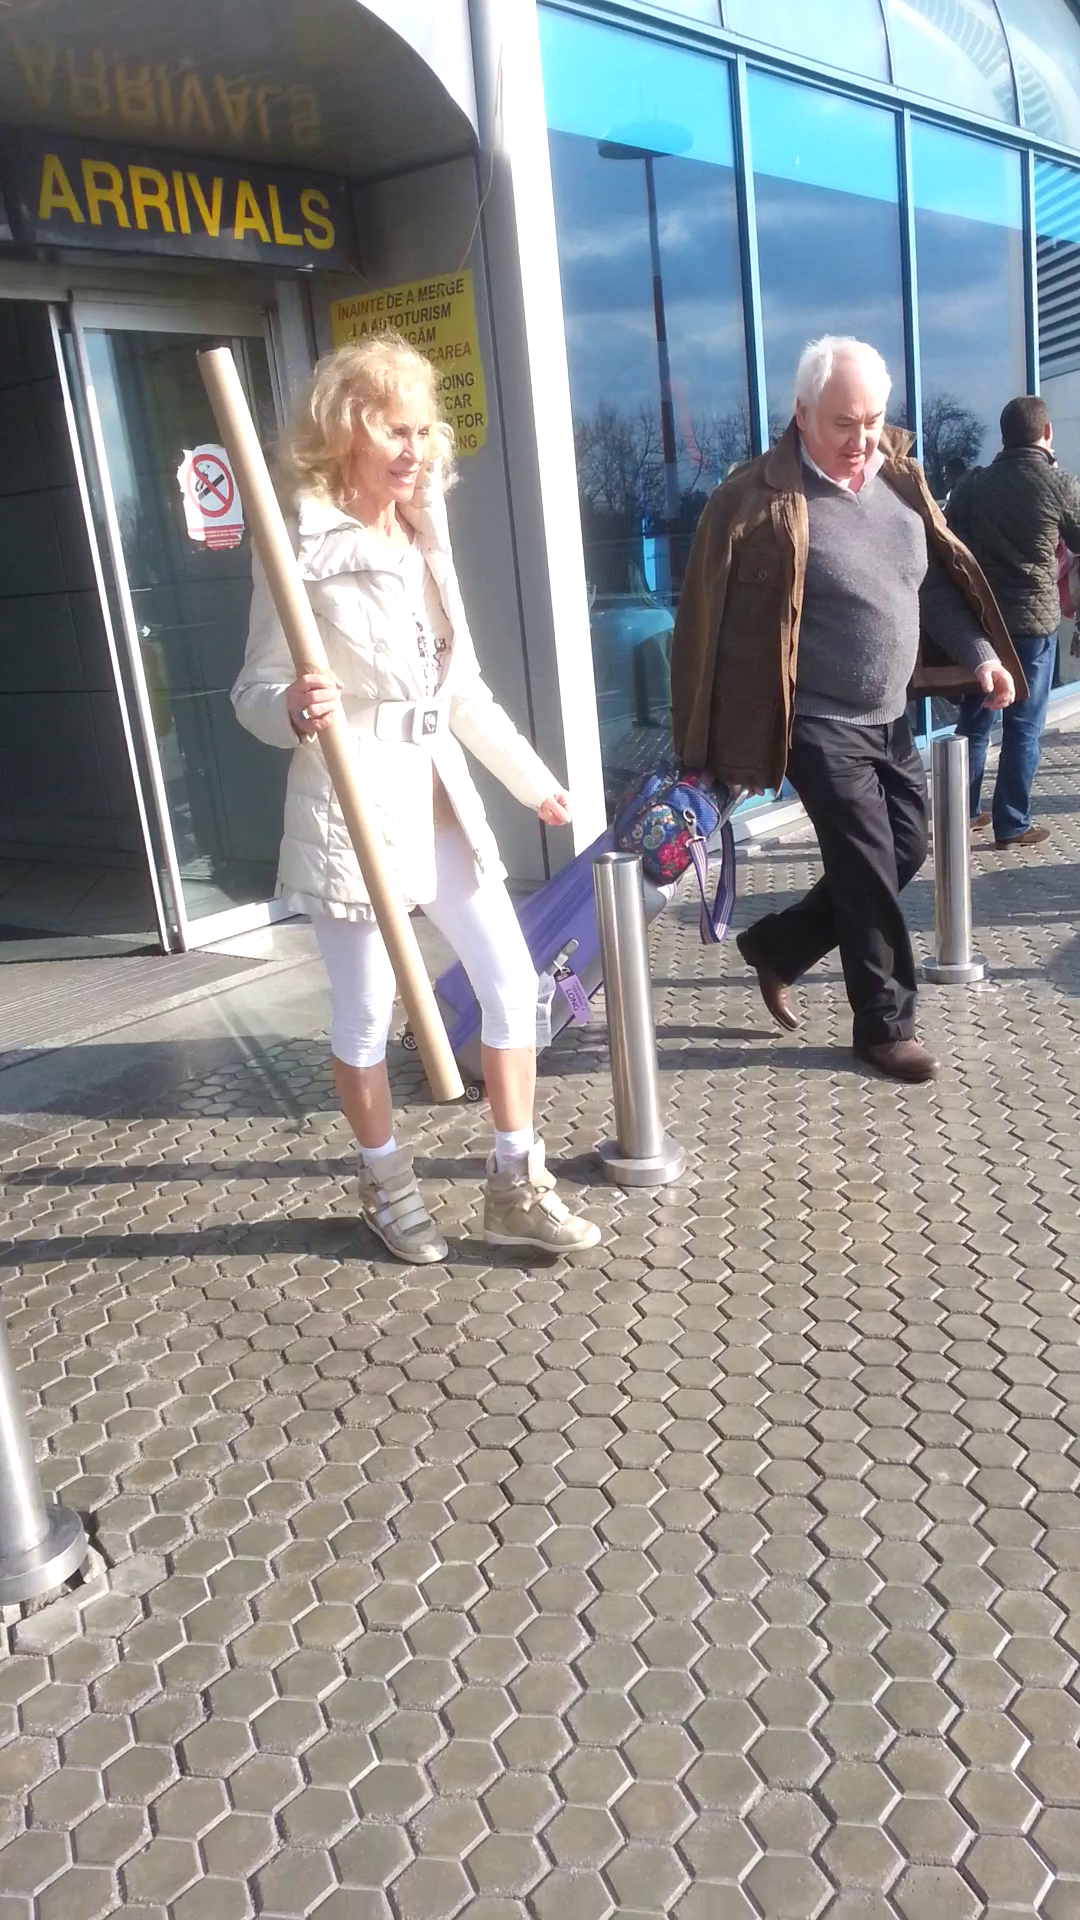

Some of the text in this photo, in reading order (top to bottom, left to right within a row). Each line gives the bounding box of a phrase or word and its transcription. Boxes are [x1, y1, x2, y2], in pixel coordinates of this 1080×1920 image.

[39, 154, 336, 249] ARRIVALS
[387, 292, 402, 309] DE
[406, 290, 414, 305] A
[418, 278, 464, 302] MERGE
[371, 302, 451, 331] AUTOTURISM
[444, 394, 472, 410] CAR
[457, 412, 484, 428] FOR
[565, 988, 580, 1011] LONG
